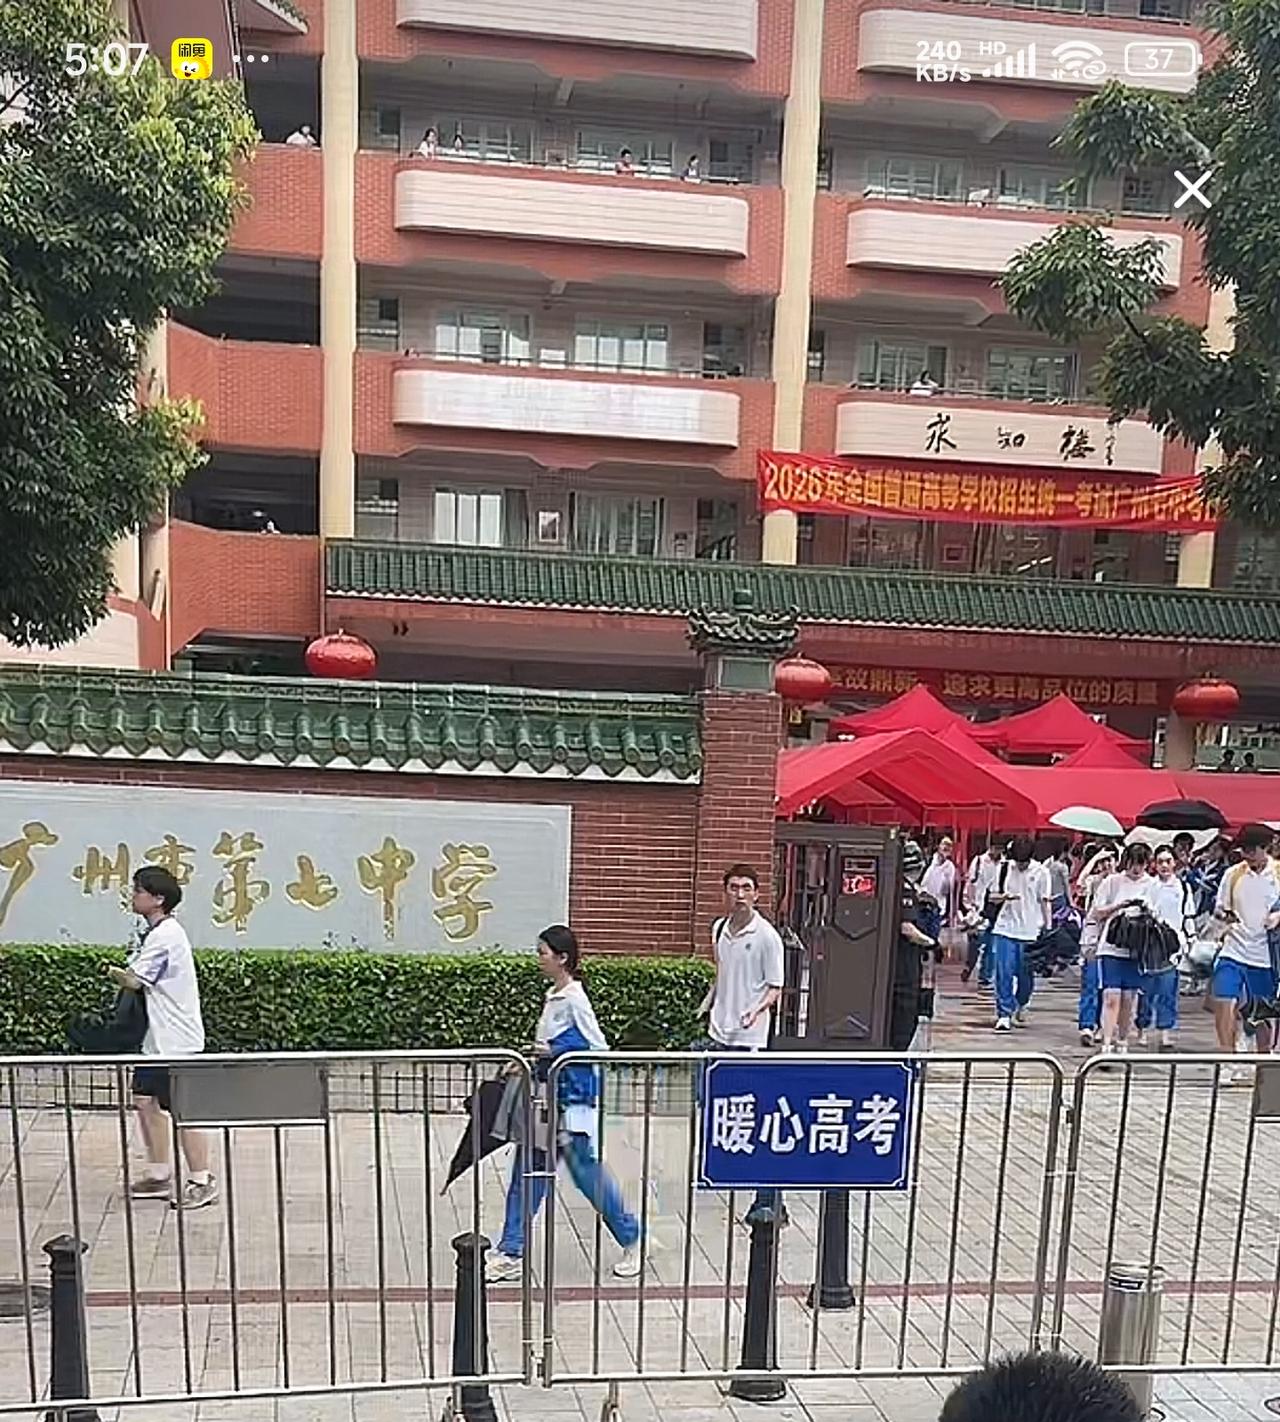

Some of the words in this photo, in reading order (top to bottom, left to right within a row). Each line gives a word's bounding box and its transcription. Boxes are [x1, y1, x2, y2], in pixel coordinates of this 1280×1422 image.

[925, 412, 1097, 462] 求知楼
[711, 1092, 901, 1156] 暖心高考
